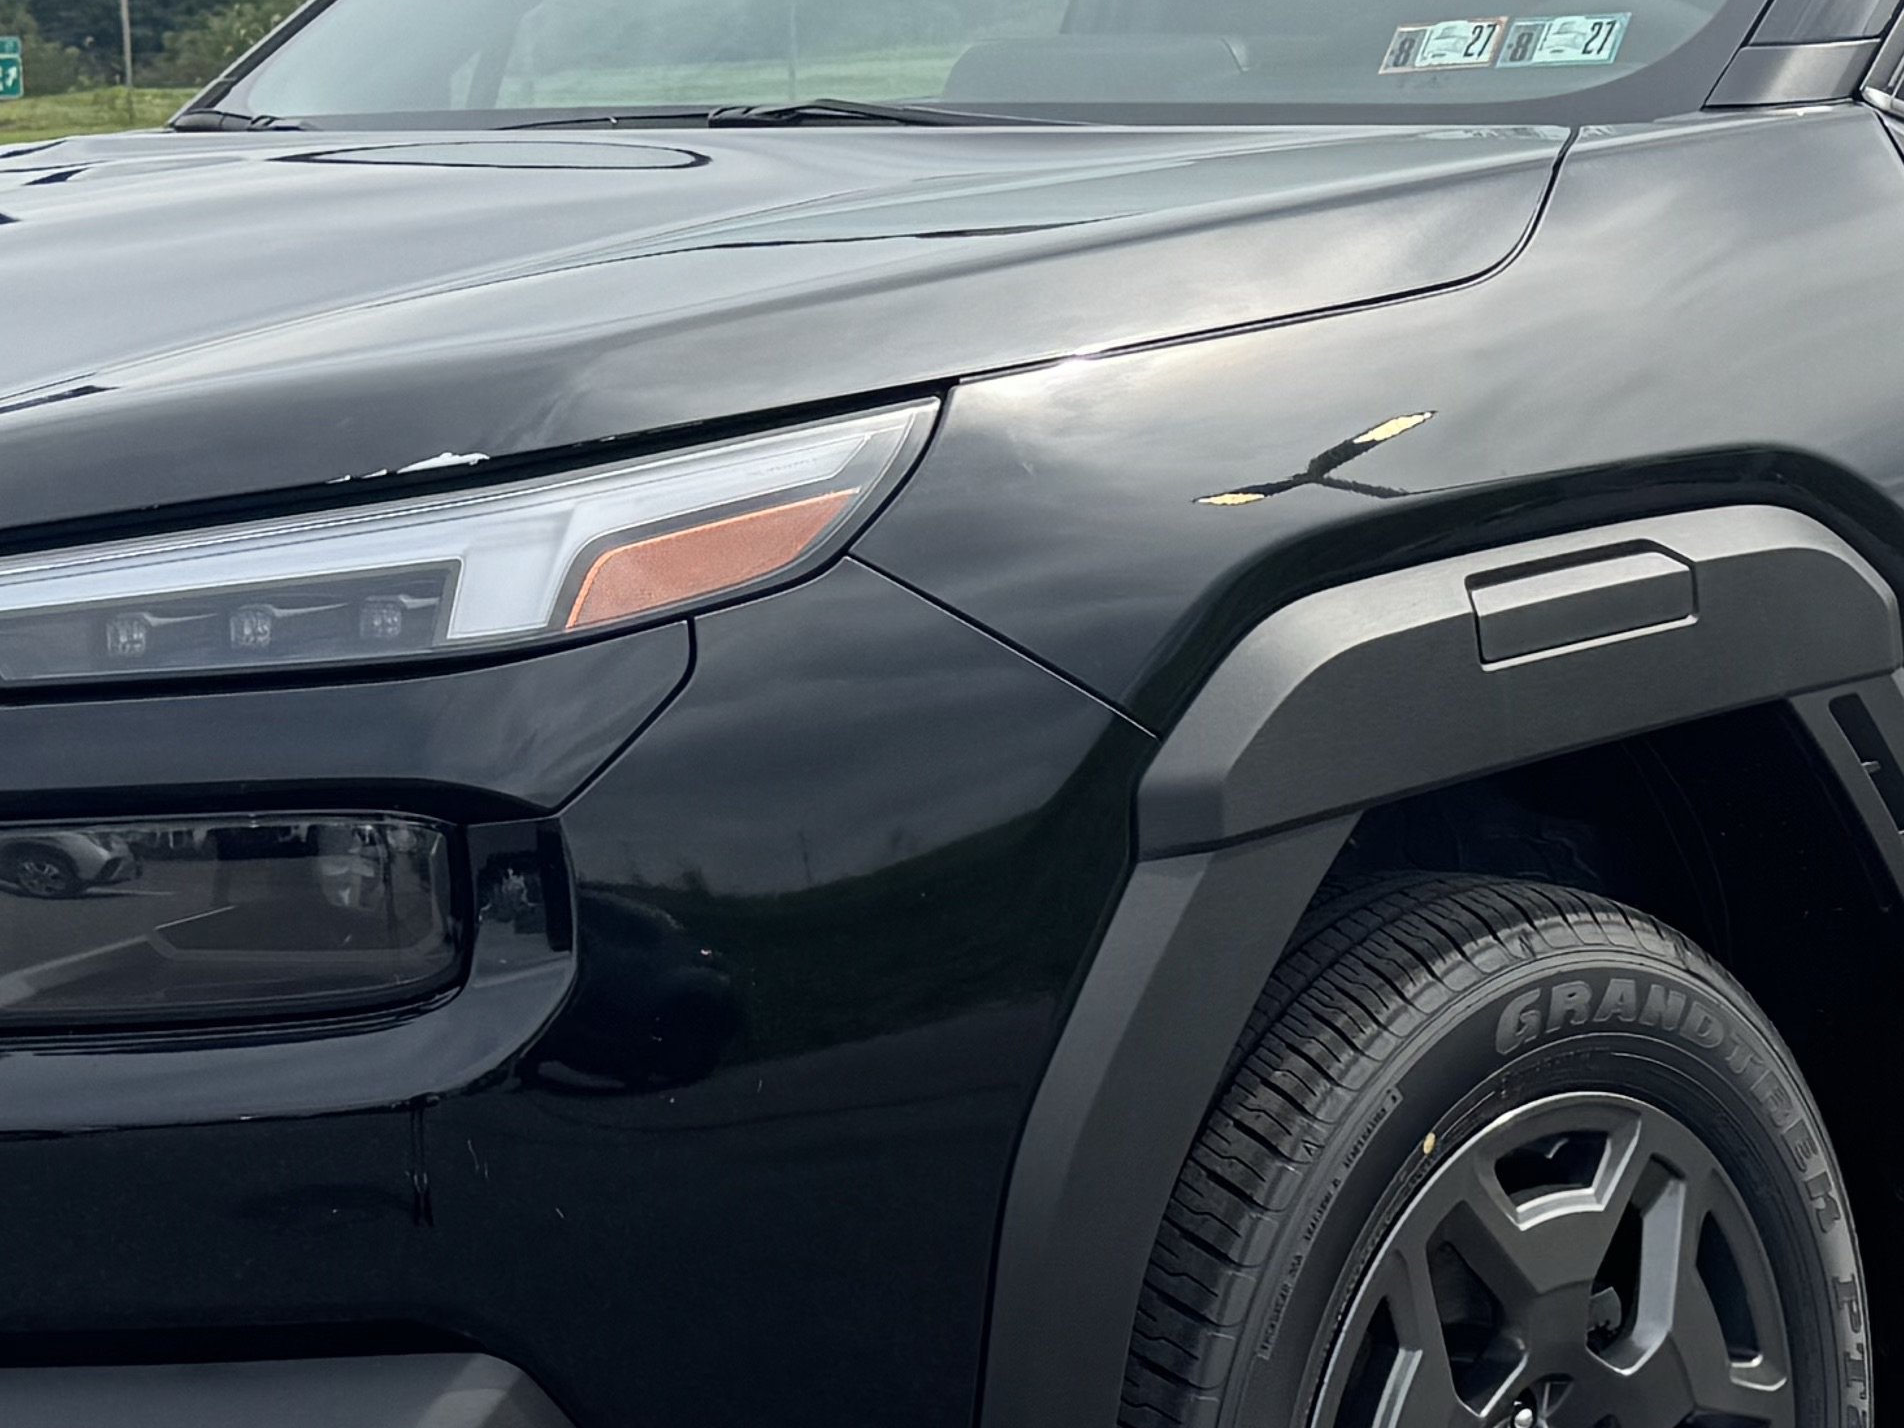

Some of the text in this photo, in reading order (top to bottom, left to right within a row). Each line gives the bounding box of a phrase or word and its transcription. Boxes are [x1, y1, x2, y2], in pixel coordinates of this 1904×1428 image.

[1463, 24, 1497, 58] 27
[1582, 20, 1617, 55] 27
[1496, 978, 1841, 1234] GRANDTREK
